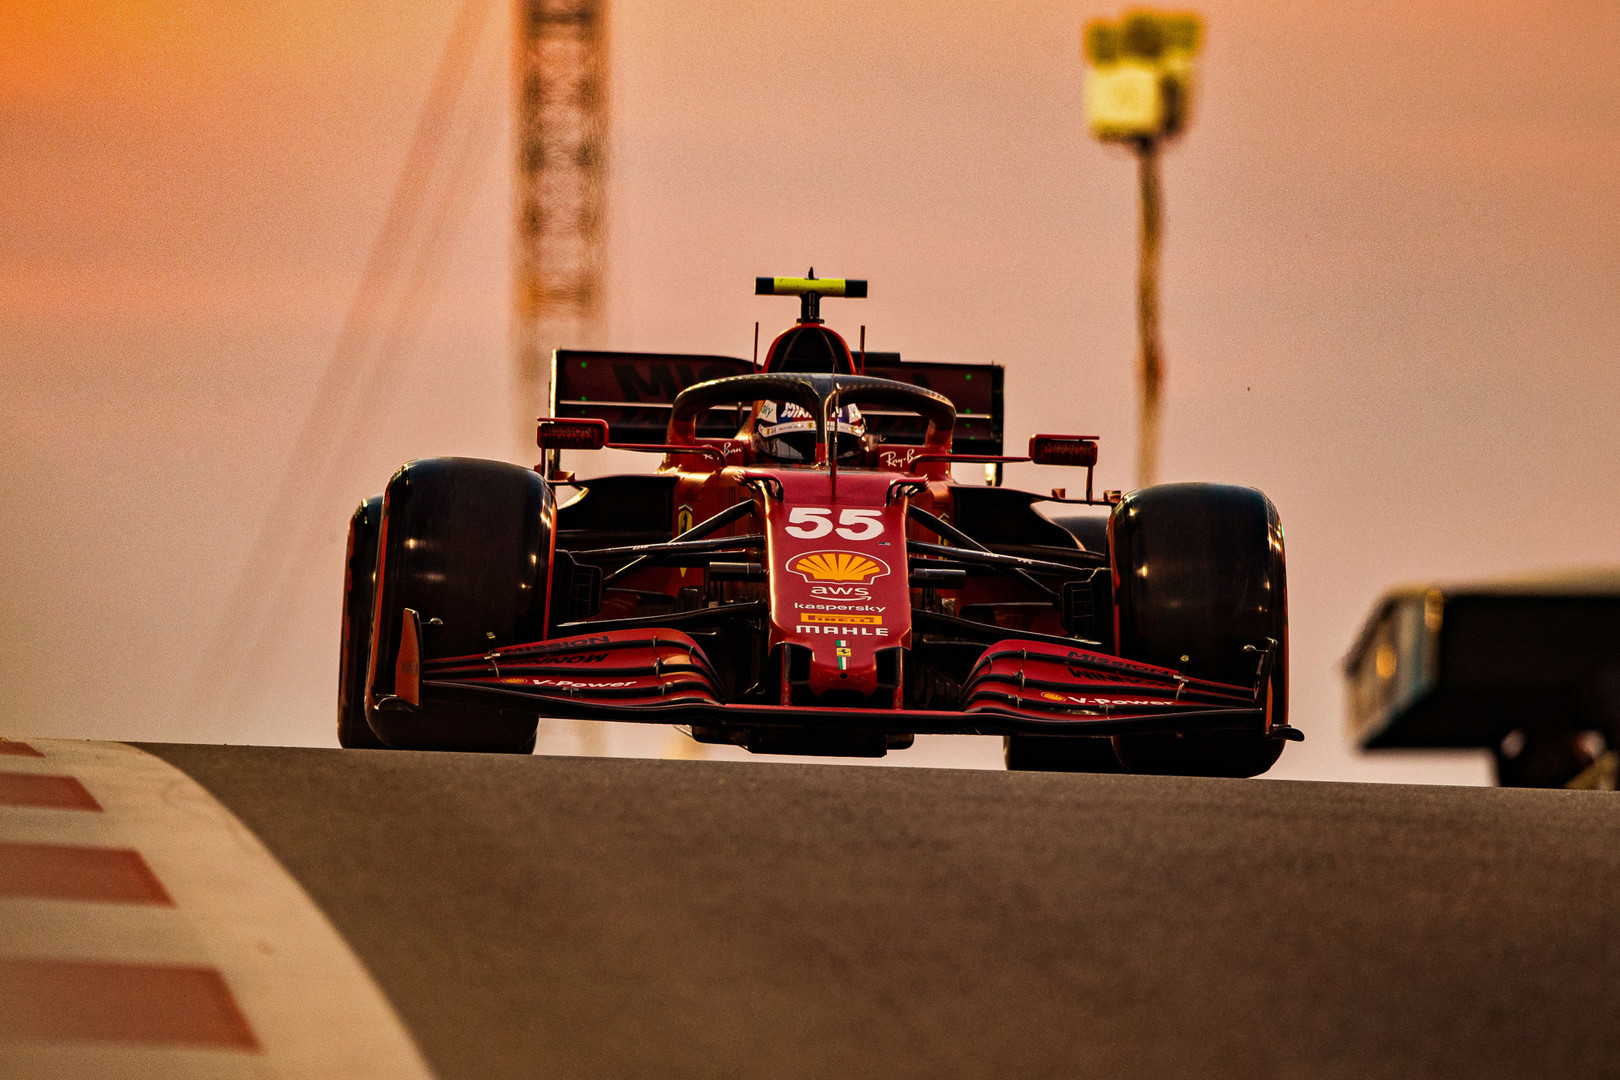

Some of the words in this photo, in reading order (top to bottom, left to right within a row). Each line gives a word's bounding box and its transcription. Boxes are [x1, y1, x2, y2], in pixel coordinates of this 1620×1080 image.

[785, 507, 885, 541] 55
[811, 586, 869, 596] aws
[794, 602, 887, 613] kaspersky
[796, 625, 889, 637] MAHLE
[503, 636, 610, 654] MISSION
[1067, 651, 1170, 675] MISSION
[533, 679, 637, 688] V-Power
[1067, 695, 1173, 705] V-Power
